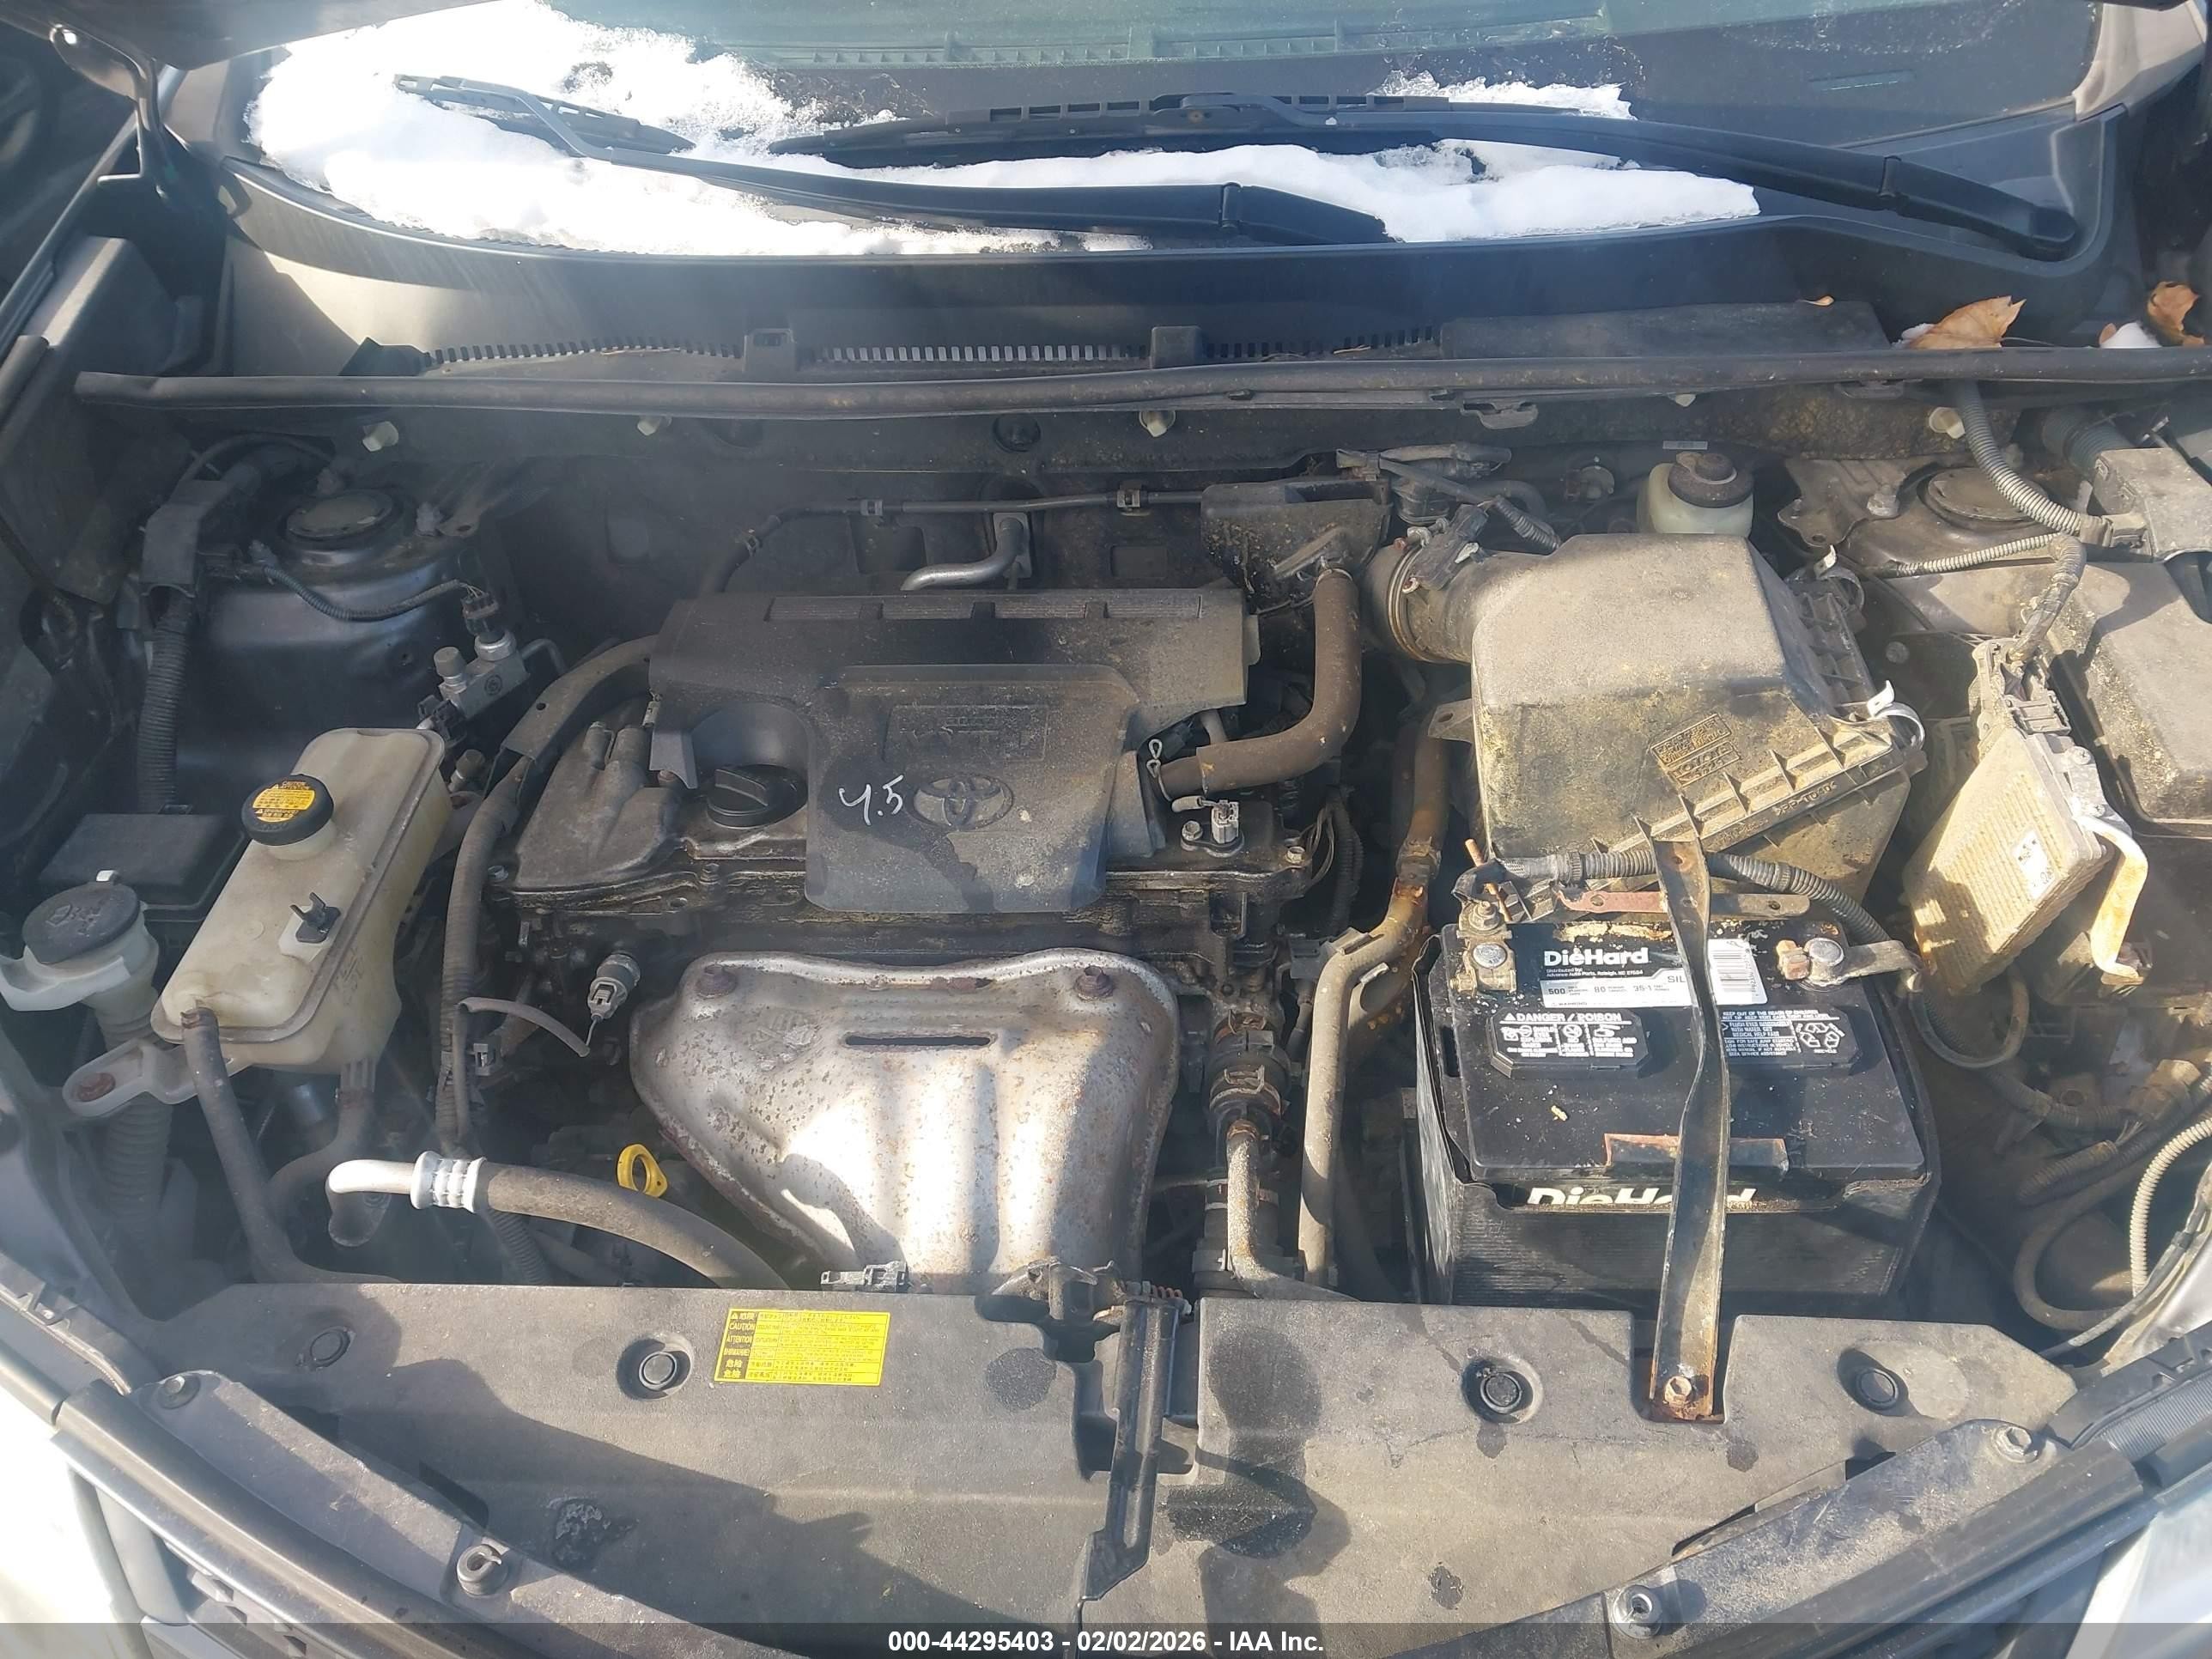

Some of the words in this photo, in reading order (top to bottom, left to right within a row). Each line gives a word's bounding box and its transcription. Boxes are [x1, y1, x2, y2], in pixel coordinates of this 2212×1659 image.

[1544, 947, 1649, 966] DieHard
[1577, 1012, 1622, 1022] POISON
[729, 1322, 756, 1331] CAUTION
[726, 1334, 752, 1344] ATTENTION
